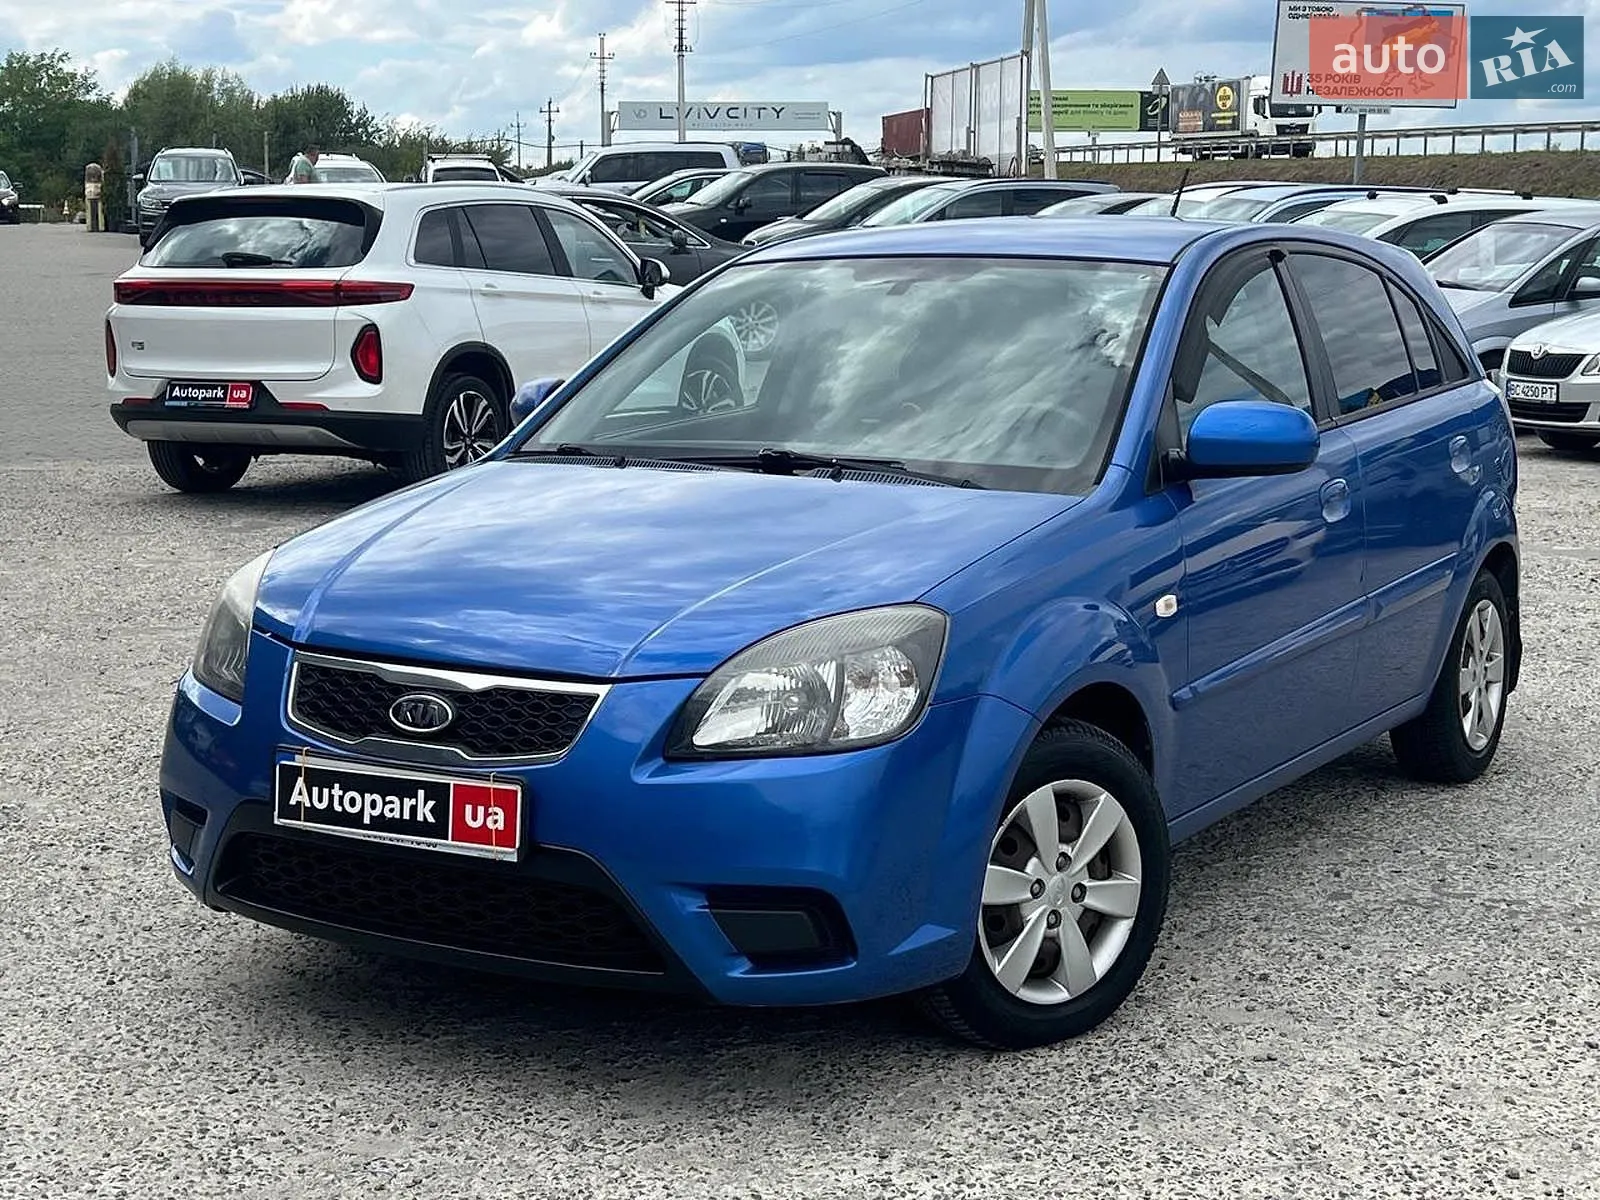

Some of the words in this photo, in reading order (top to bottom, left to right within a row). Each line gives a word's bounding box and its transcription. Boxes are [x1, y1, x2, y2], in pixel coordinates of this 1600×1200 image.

[1306, 73, 1323, 83] 35
[1325, 74, 1361, 84] РОКІВ
[1306, 86, 1403, 97] НЕЗАЛЕЖНОСТІ
[172, 387, 224, 400] Autopark
[232, 389, 247, 398] ua
[1541, 386, 1555, 399] PT
[289, 776, 437, 825] Autopark
[464, 803, 505, 830] ua
